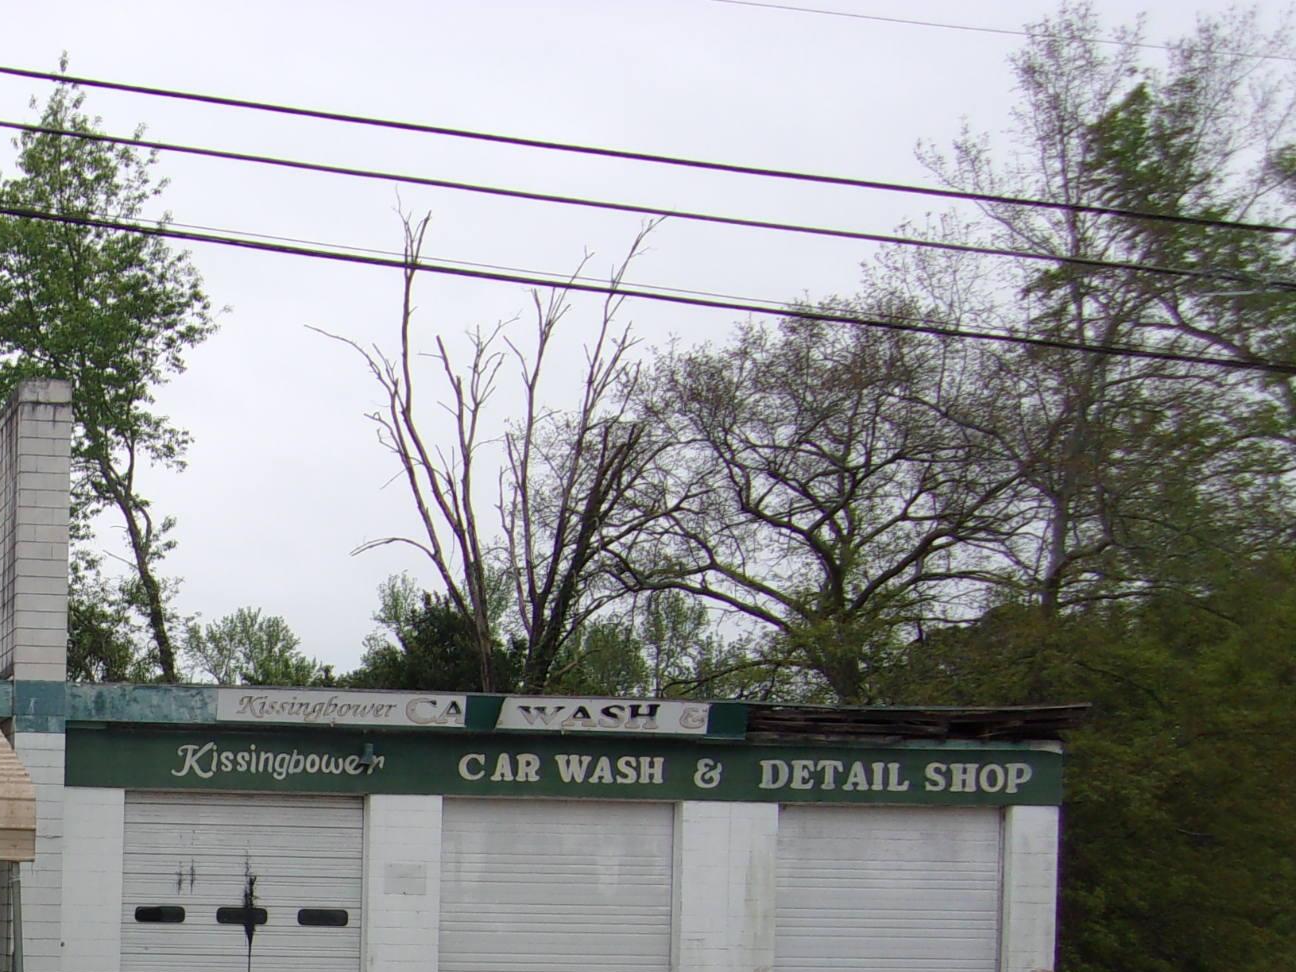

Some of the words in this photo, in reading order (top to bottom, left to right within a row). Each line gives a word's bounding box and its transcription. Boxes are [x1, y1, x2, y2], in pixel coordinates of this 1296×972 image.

[235, 694, 399, 722] Kissingbower
[405, 697, 466, 725] CA
[517, 702, 661, 730] WASH
[170, 741, 385, 780] Kissingbower
[457, 752, 540, 782] CAR
[554, 754, 665, 785] WASH
[693, 758, 723, 789] &
[758, 759, 910, 792] DETAIL
[924, 761, 1033, 794] SHOP
